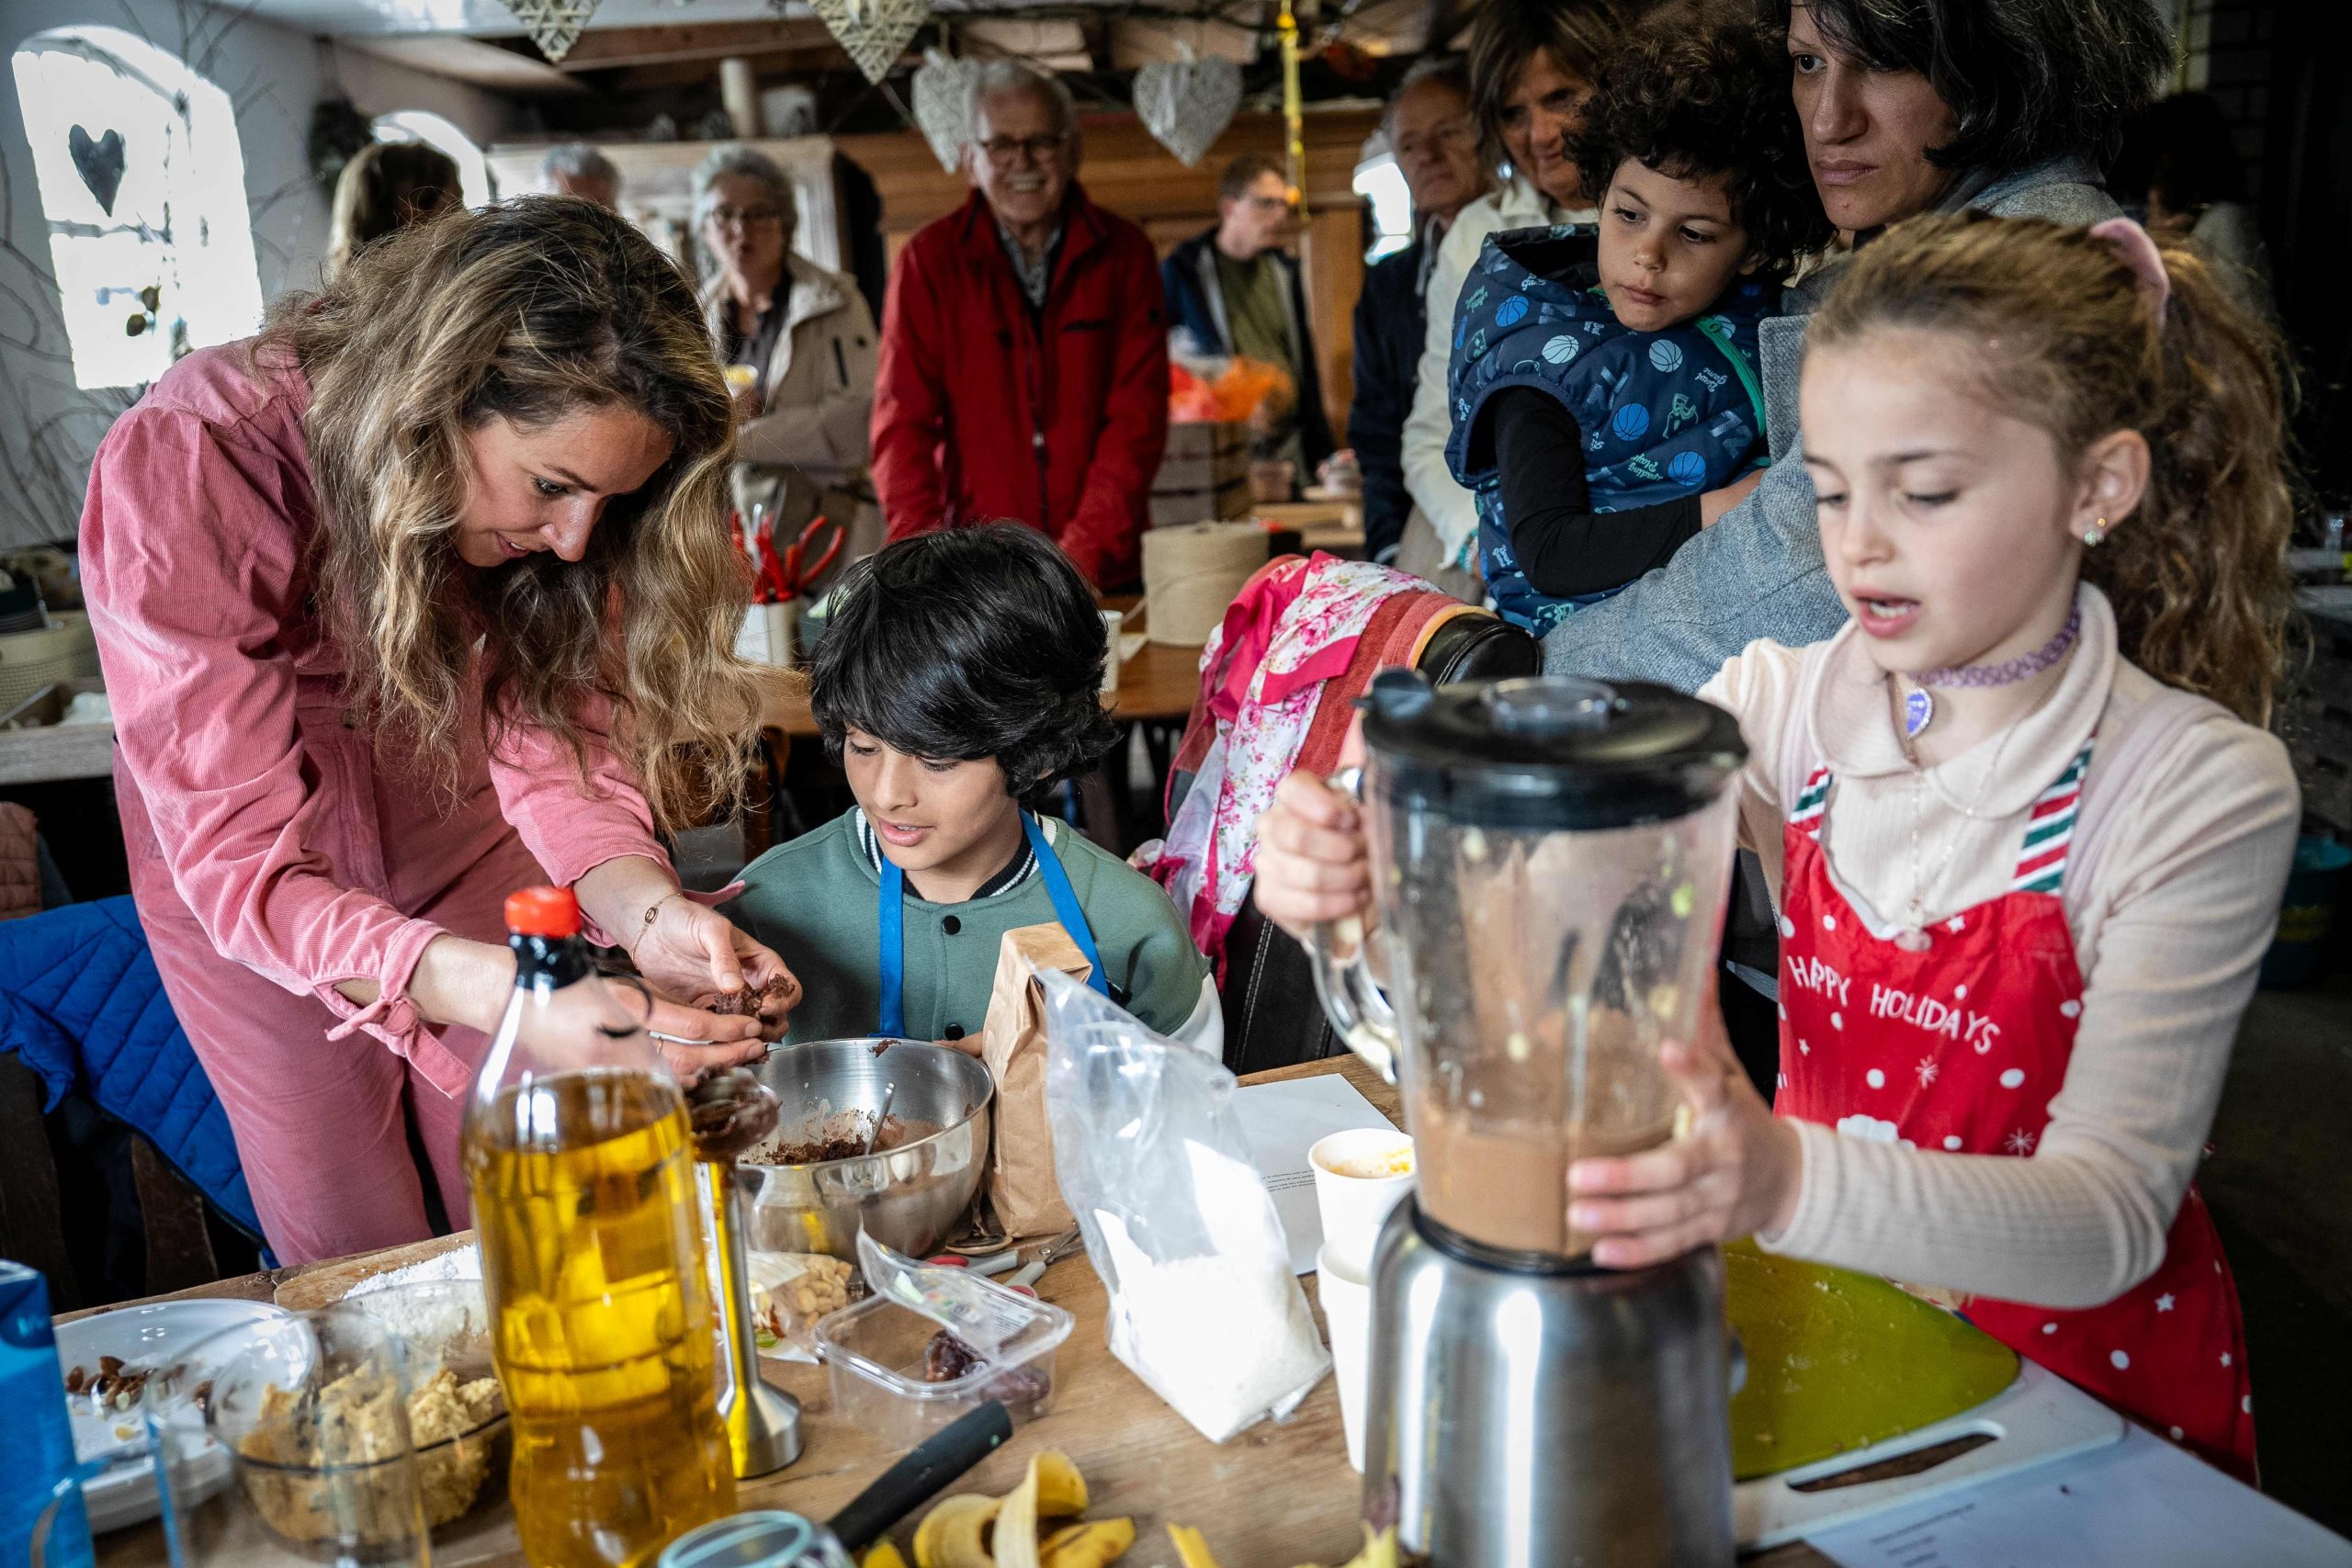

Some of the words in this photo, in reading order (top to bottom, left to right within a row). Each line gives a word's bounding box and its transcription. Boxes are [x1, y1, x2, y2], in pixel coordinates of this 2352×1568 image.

[1694, 372, 1718, 392] Bowl
[1702, 367, 1727, 385] Game
[1786, 955, 1851, 1007] HAPPY
[1870, 983, 2002, 1055] HOLIDAYS
